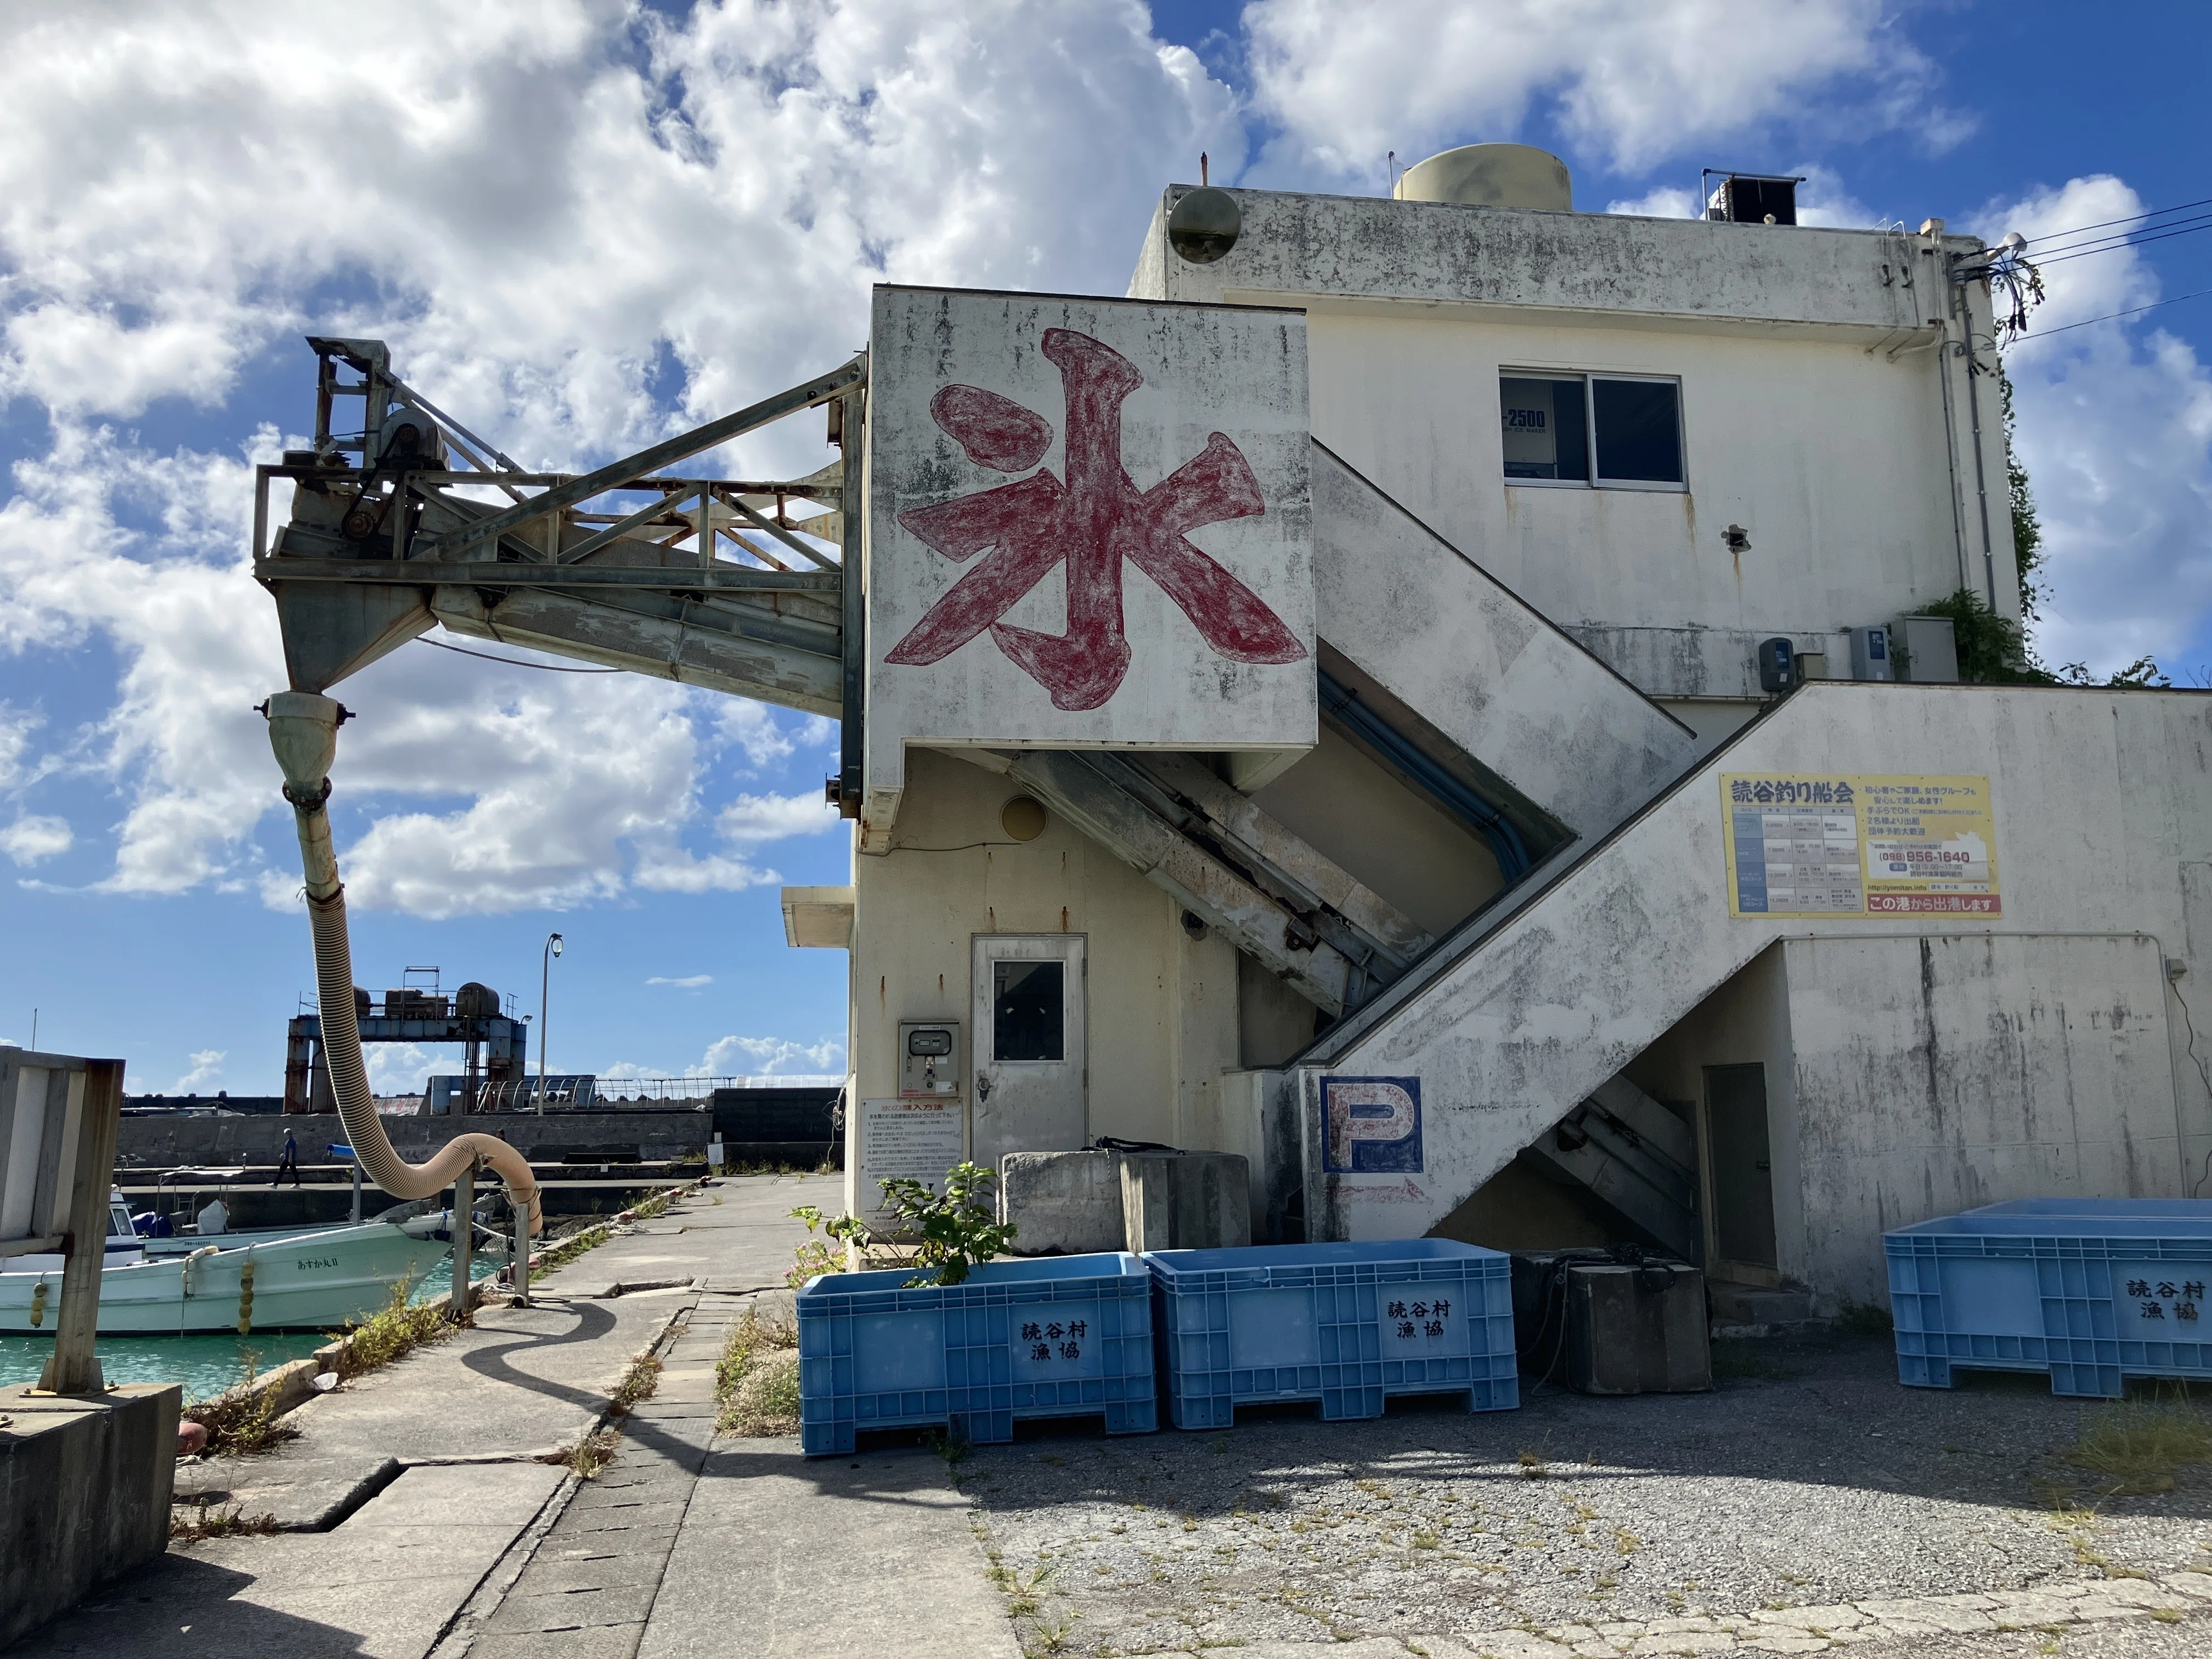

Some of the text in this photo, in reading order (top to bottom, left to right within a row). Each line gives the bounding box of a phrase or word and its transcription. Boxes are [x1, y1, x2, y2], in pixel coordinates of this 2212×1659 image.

[884, 328, 1308, 711] 氷
[1731, 780, 1854, 804] 読谷釣り船会
[1869, 827, 1926, 836] 団体予約大歓迎
[1870, 896, 1991, 911] この港から出港します
[1327, 1083, 1414, 1168] P
[2126, 1279, 2206, 1299] 読谷村
[1387, 1299, 1451, 1319] 読谷村
[2141, 1301, 2199, 1321] 漁協
[1020, 1319, 1088, 1342] 読谷村
[1396, 1320, 1444, 1339] 漁協
[1031, 1342, 1080, 1361] 漁協
